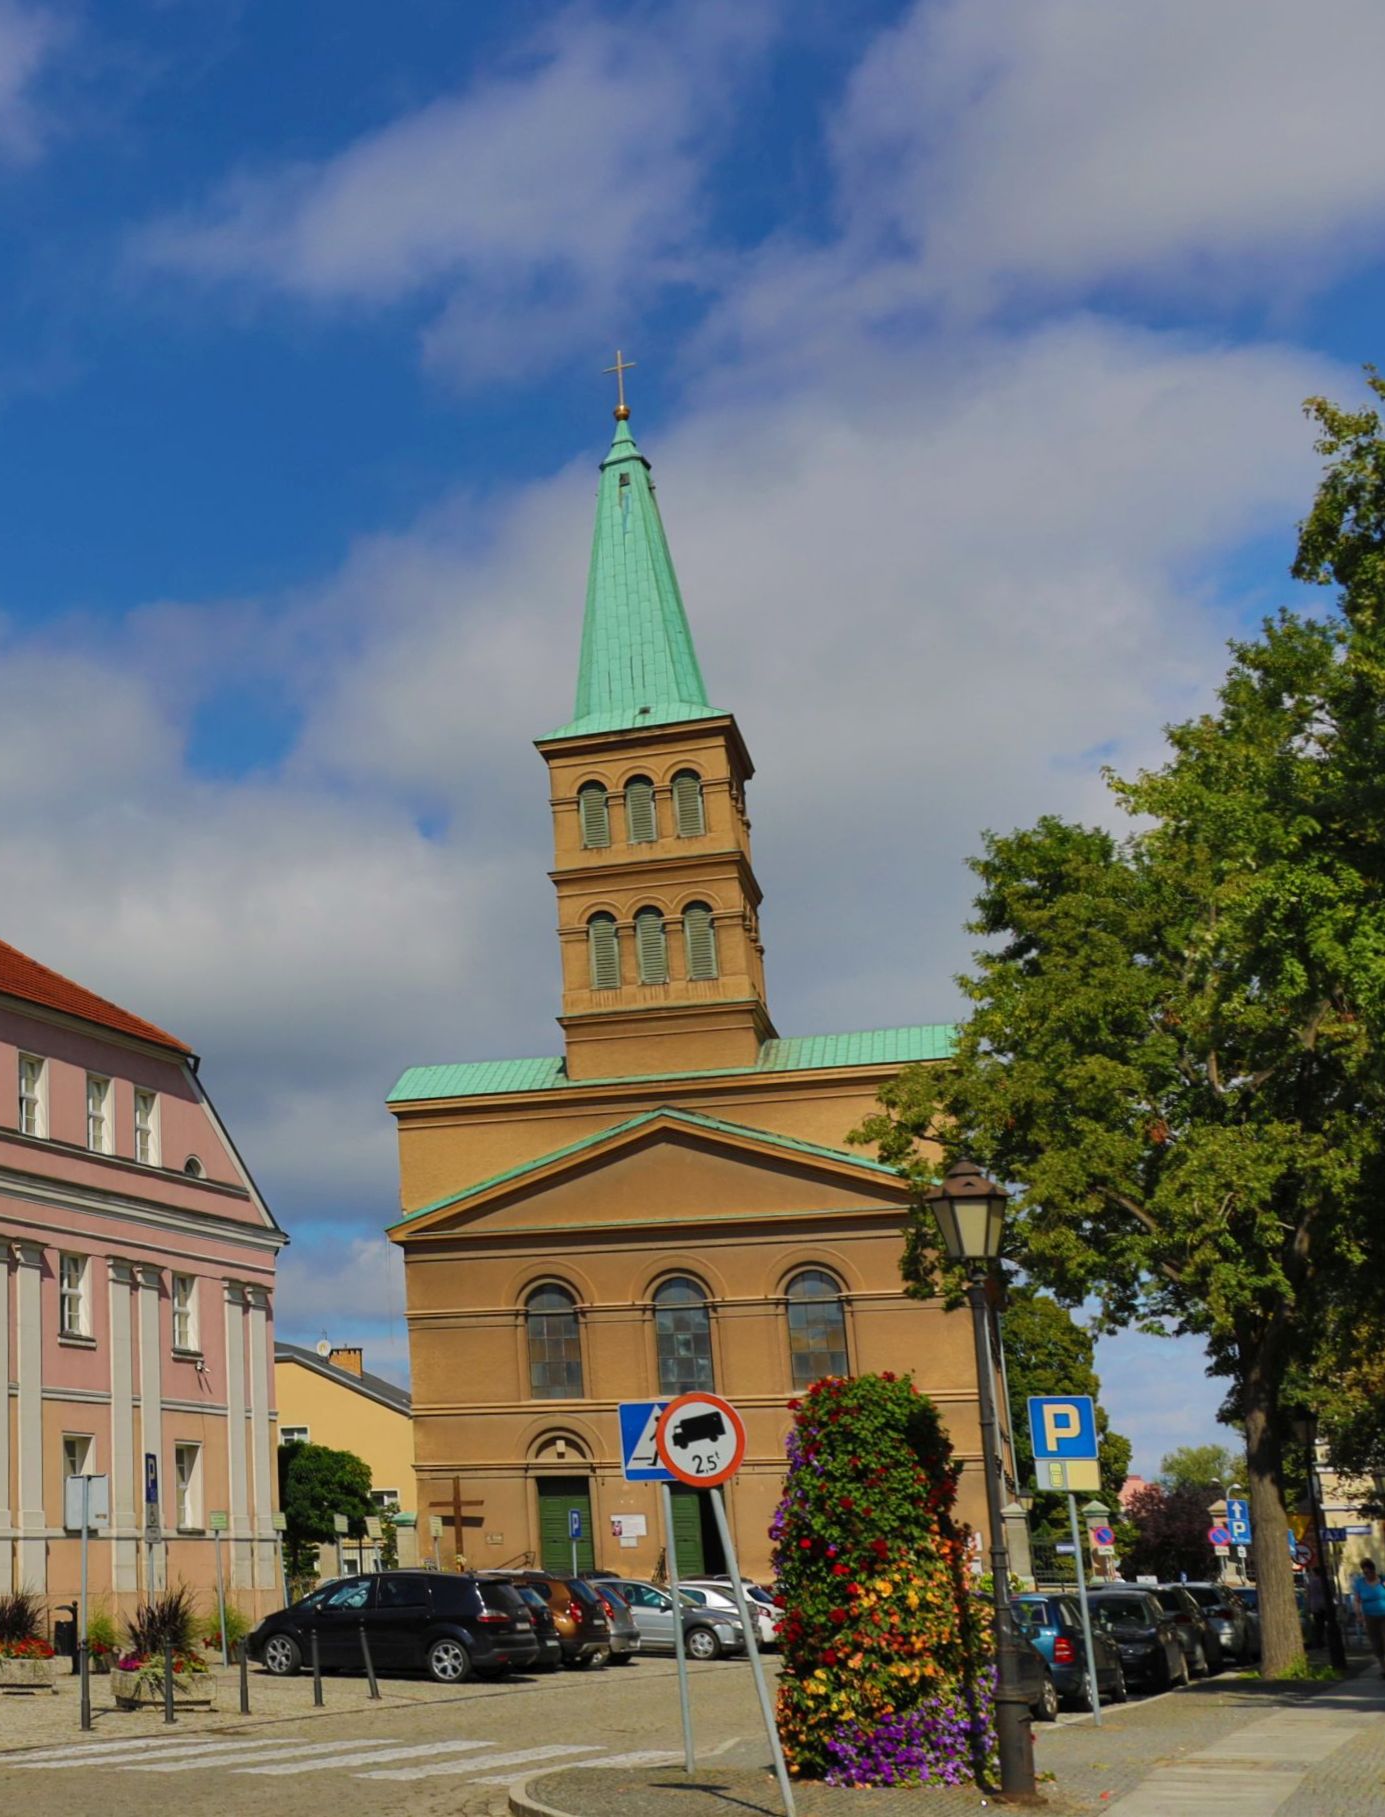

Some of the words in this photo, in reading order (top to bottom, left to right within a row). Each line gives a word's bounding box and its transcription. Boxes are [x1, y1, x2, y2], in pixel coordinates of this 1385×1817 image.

[1042, 1404, 1081, 1451] P
[148, 1458, 155, 1487] P
[572, 1512, 579, 1535] P
[1232, 1521, 1246, 1537] P
